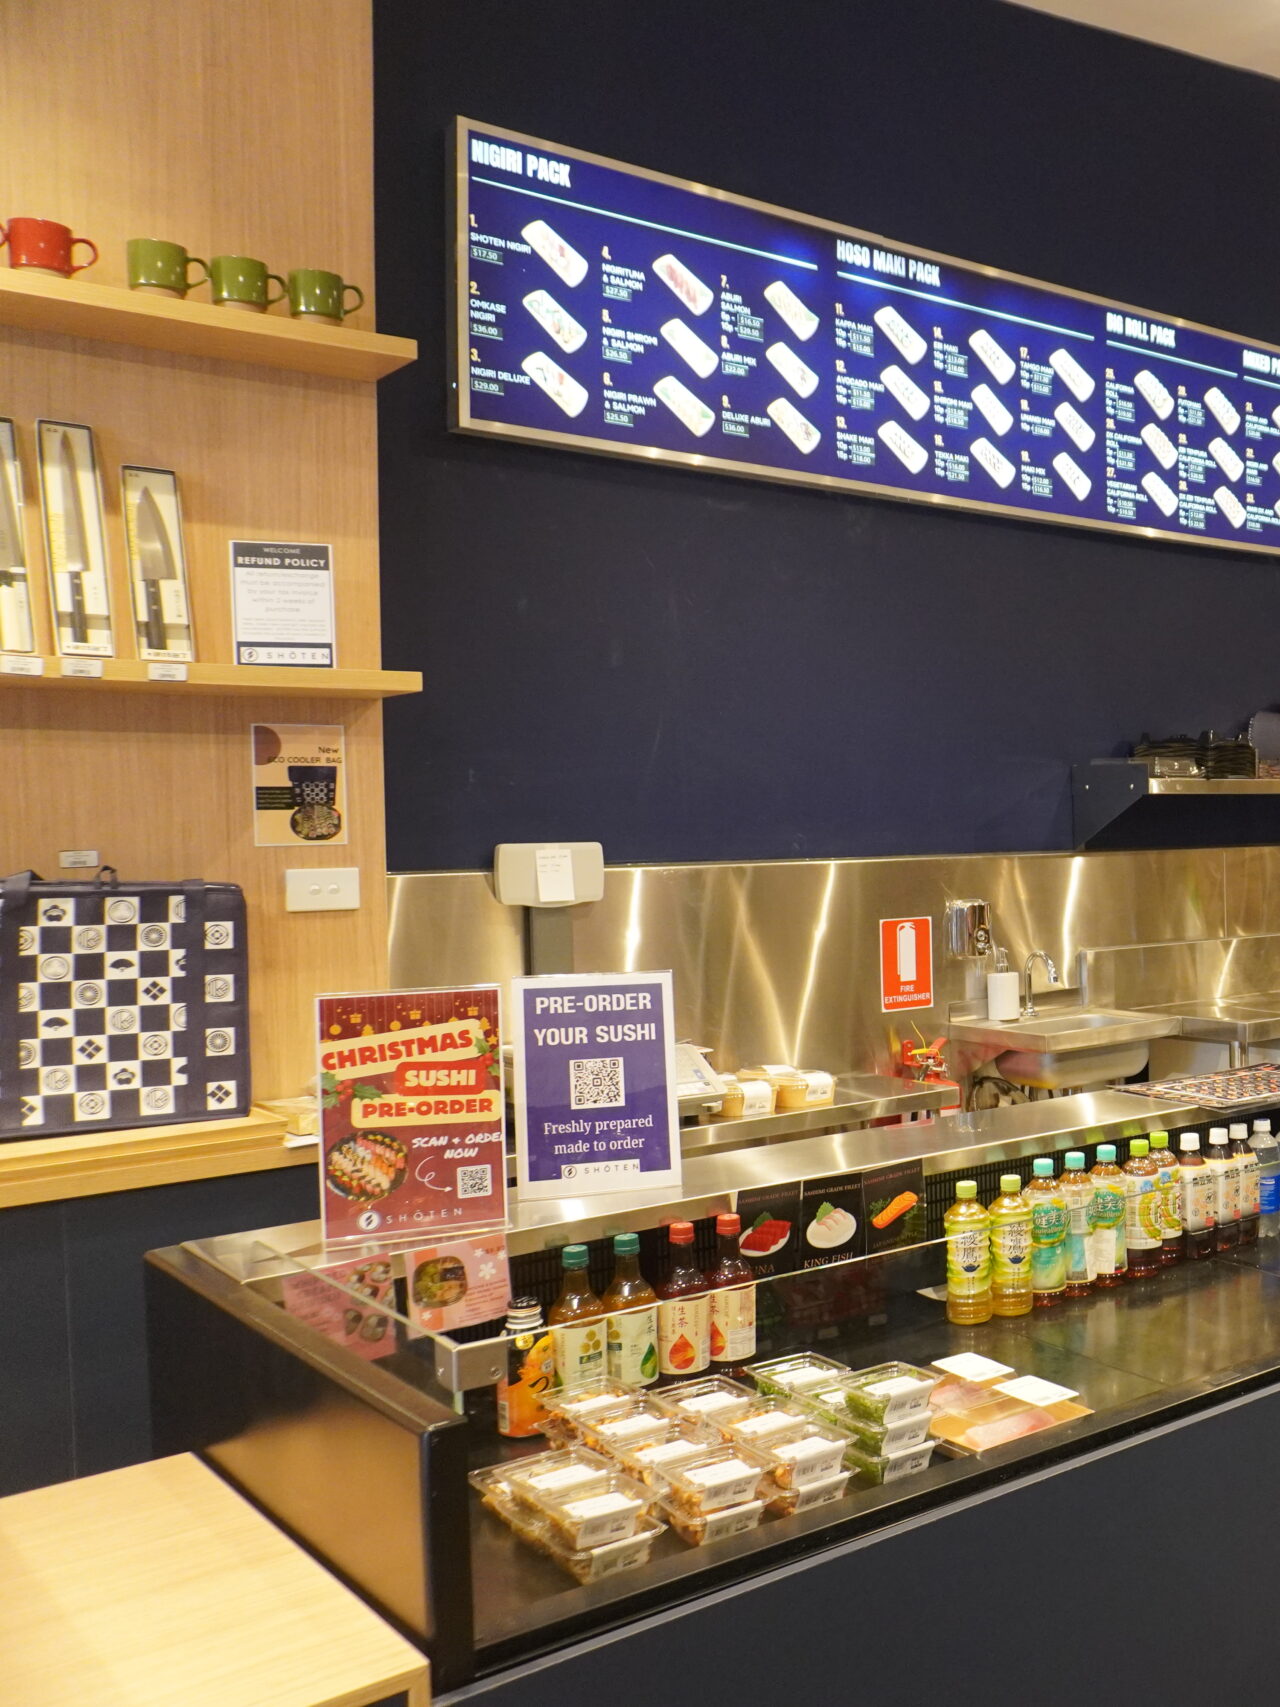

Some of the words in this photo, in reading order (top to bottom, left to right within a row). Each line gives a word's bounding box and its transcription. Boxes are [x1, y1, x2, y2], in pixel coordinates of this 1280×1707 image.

[471, 138, 523, 175] NIGIRI
[526, 153, 571, 188] PACK
[470, 232, 505, 248] SHOTEN
[507, 240, 531, 254] NIGIRI
[472, 248, 498, 260] $17.50
[837, 239, 870, 269] HOSO
[873, 249, 906, 278] MAKI
[909, 259, 940, 288] PACK
[470, 281, 480, 295] 2.
[610, 275, 643, 292] SALMON
[470, 298, 506, 314] OMKASE
[721, 292, 742, 304] ABURI
[470, 310, 496, 322] NIGIRI
[721, 302, 750, 316] SALMON
[473, 324, 498, 336] $36.00
[602, 326, 626, 340] NIGIRI
[1106, 312, 1124, 334] BIG
[1125, 317, 1148, 341] ROLL
[1150, 324, 1176, 348] PACK
[610, 338, 644, 354] SALMON
[470, 348, 481, 362] 3.
[722, 352, 742, 364] ABURI
[744, 356, 756, 368] MIX
[471, 366, 496, 379] NIGIRI
[498, 371, 531, 386] DELUXE
[836, 375, 868, 388] AVOCADO
[869, 381, 885, 392] MAKI
[474, 380, 499, 392] $29.00
[604, 389, 626, 402] NIGIRI
[628, 392, 656, 408] PRAWN
[612, 401, 646, 416] SALMON
[722, 410, 750, 424] DELUXE
[750, 415, 771, 427] ABURI
[836, 432, 858, 443] SHAKE
[858, 435, 874, 446] MAKI
[237, 556, 281, 566] REFUND
[284, 558, 326, 568] POLICY
[900, 984, 914, 992] FIRE
[535, 992, 652, 1015] PRE-ORDER
[884, 992, 930, 1004] EXTINGUISHER
[534, 1026, 588, 1046] YOUR
[596, 1023, 656, 1044] SUSHI
[321, 1029, 474, 1071] CHRISTMAS
[404, 1069, 476, 1087] SUSHI
[362, 1098, 494, 1119] PRE-ORDER
[544, 1120, 592, 1135] Freshly
[595, 1114, 653, 1134] prepared
[412, 1136, 448, 1149] SCAN
[554, 1140, 590, 1154] made
[593, 1140, 606, 1151] to
[610, 1136, 645, 1150] order
[444, 1148, 478, 1160] NOW
[781, 1190, 800, 1198] FILLET
[804, 1189, 826, 1199] SASHIMI
[826, 1186, 844, 1194] GRADE
[844, 1184, 863, 1192] FILLET
[804, 1257, 829, 1270] KING
[832, 1252, 854, 1265] FISH
[678, 1305, 688, 1328] 生茶
